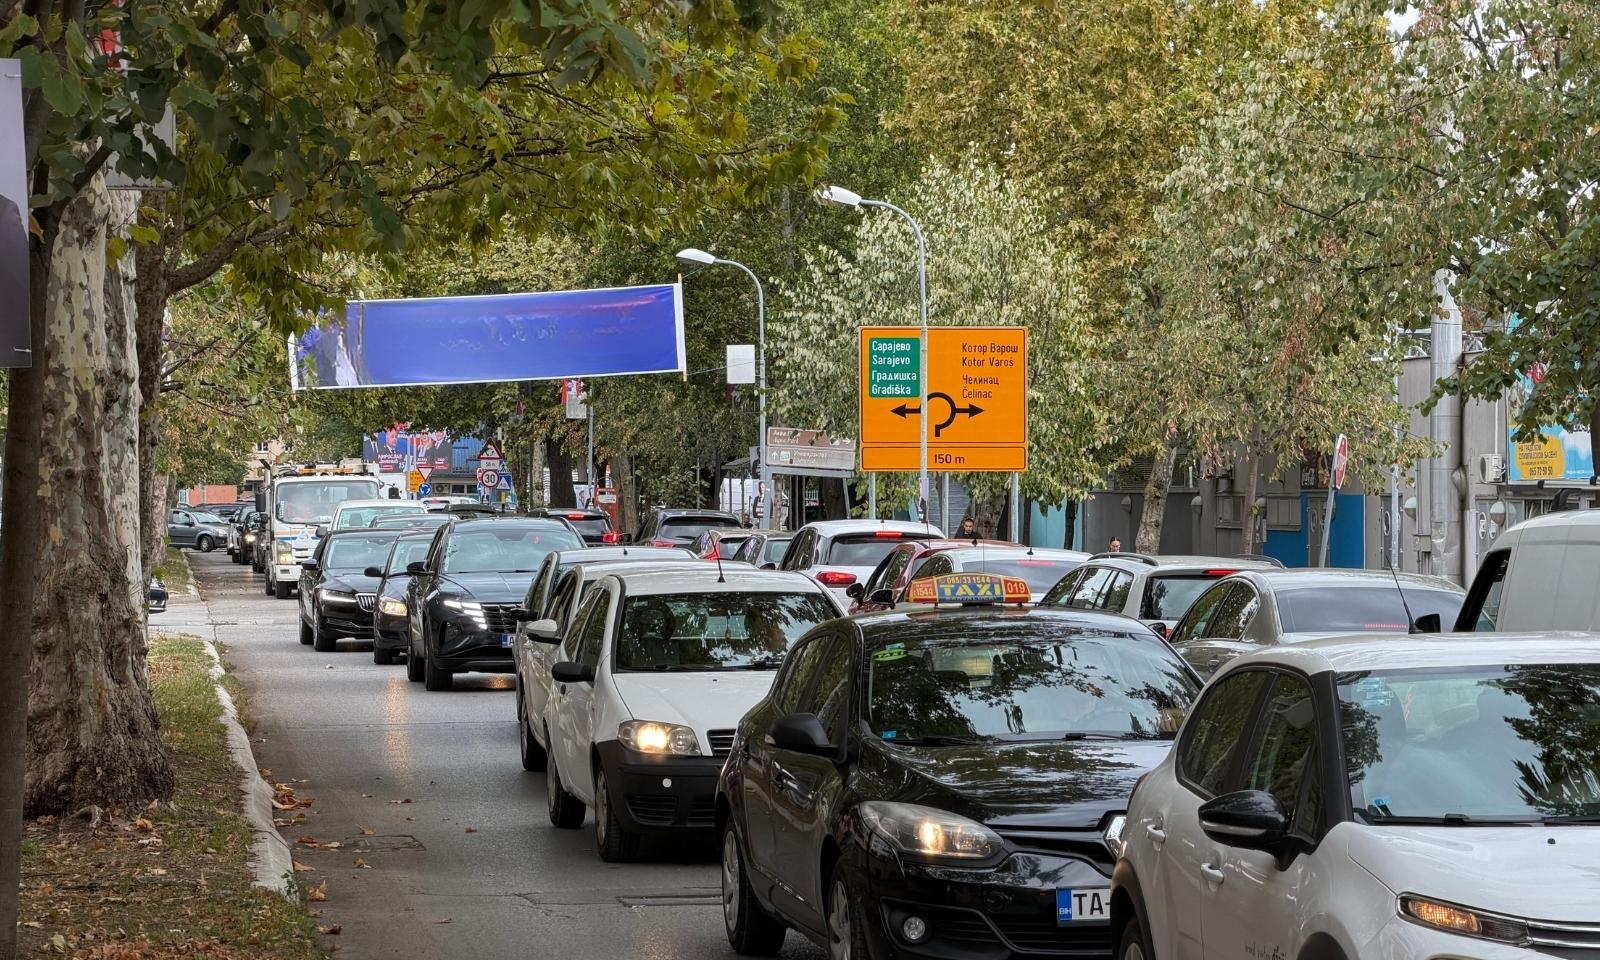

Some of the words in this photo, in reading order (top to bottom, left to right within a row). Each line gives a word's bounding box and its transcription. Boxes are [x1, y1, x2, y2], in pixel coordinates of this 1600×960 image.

[871, 340, 911, 354] Сарајево
[962, 343, 988, 355] Котор
[990, 343, 1019, 355] Варош
[872, 355, 911, 368] Sarajevo
[962, 357, 986, 367] Kotor
[871, 370, 917, 382] Градишка
[962, 374, 999, 386] Челинац
[872, 383, 911, 395] Gradiška
[962, 386, 993, 399] Čelinac
[933, 454, 952, 464] 150
[955, 456, 965, 464] m
[485, 474, 495, 483] 30
[940, 584, 1002, 596] TAXI
[1007, 582, 1026, 594] 019
